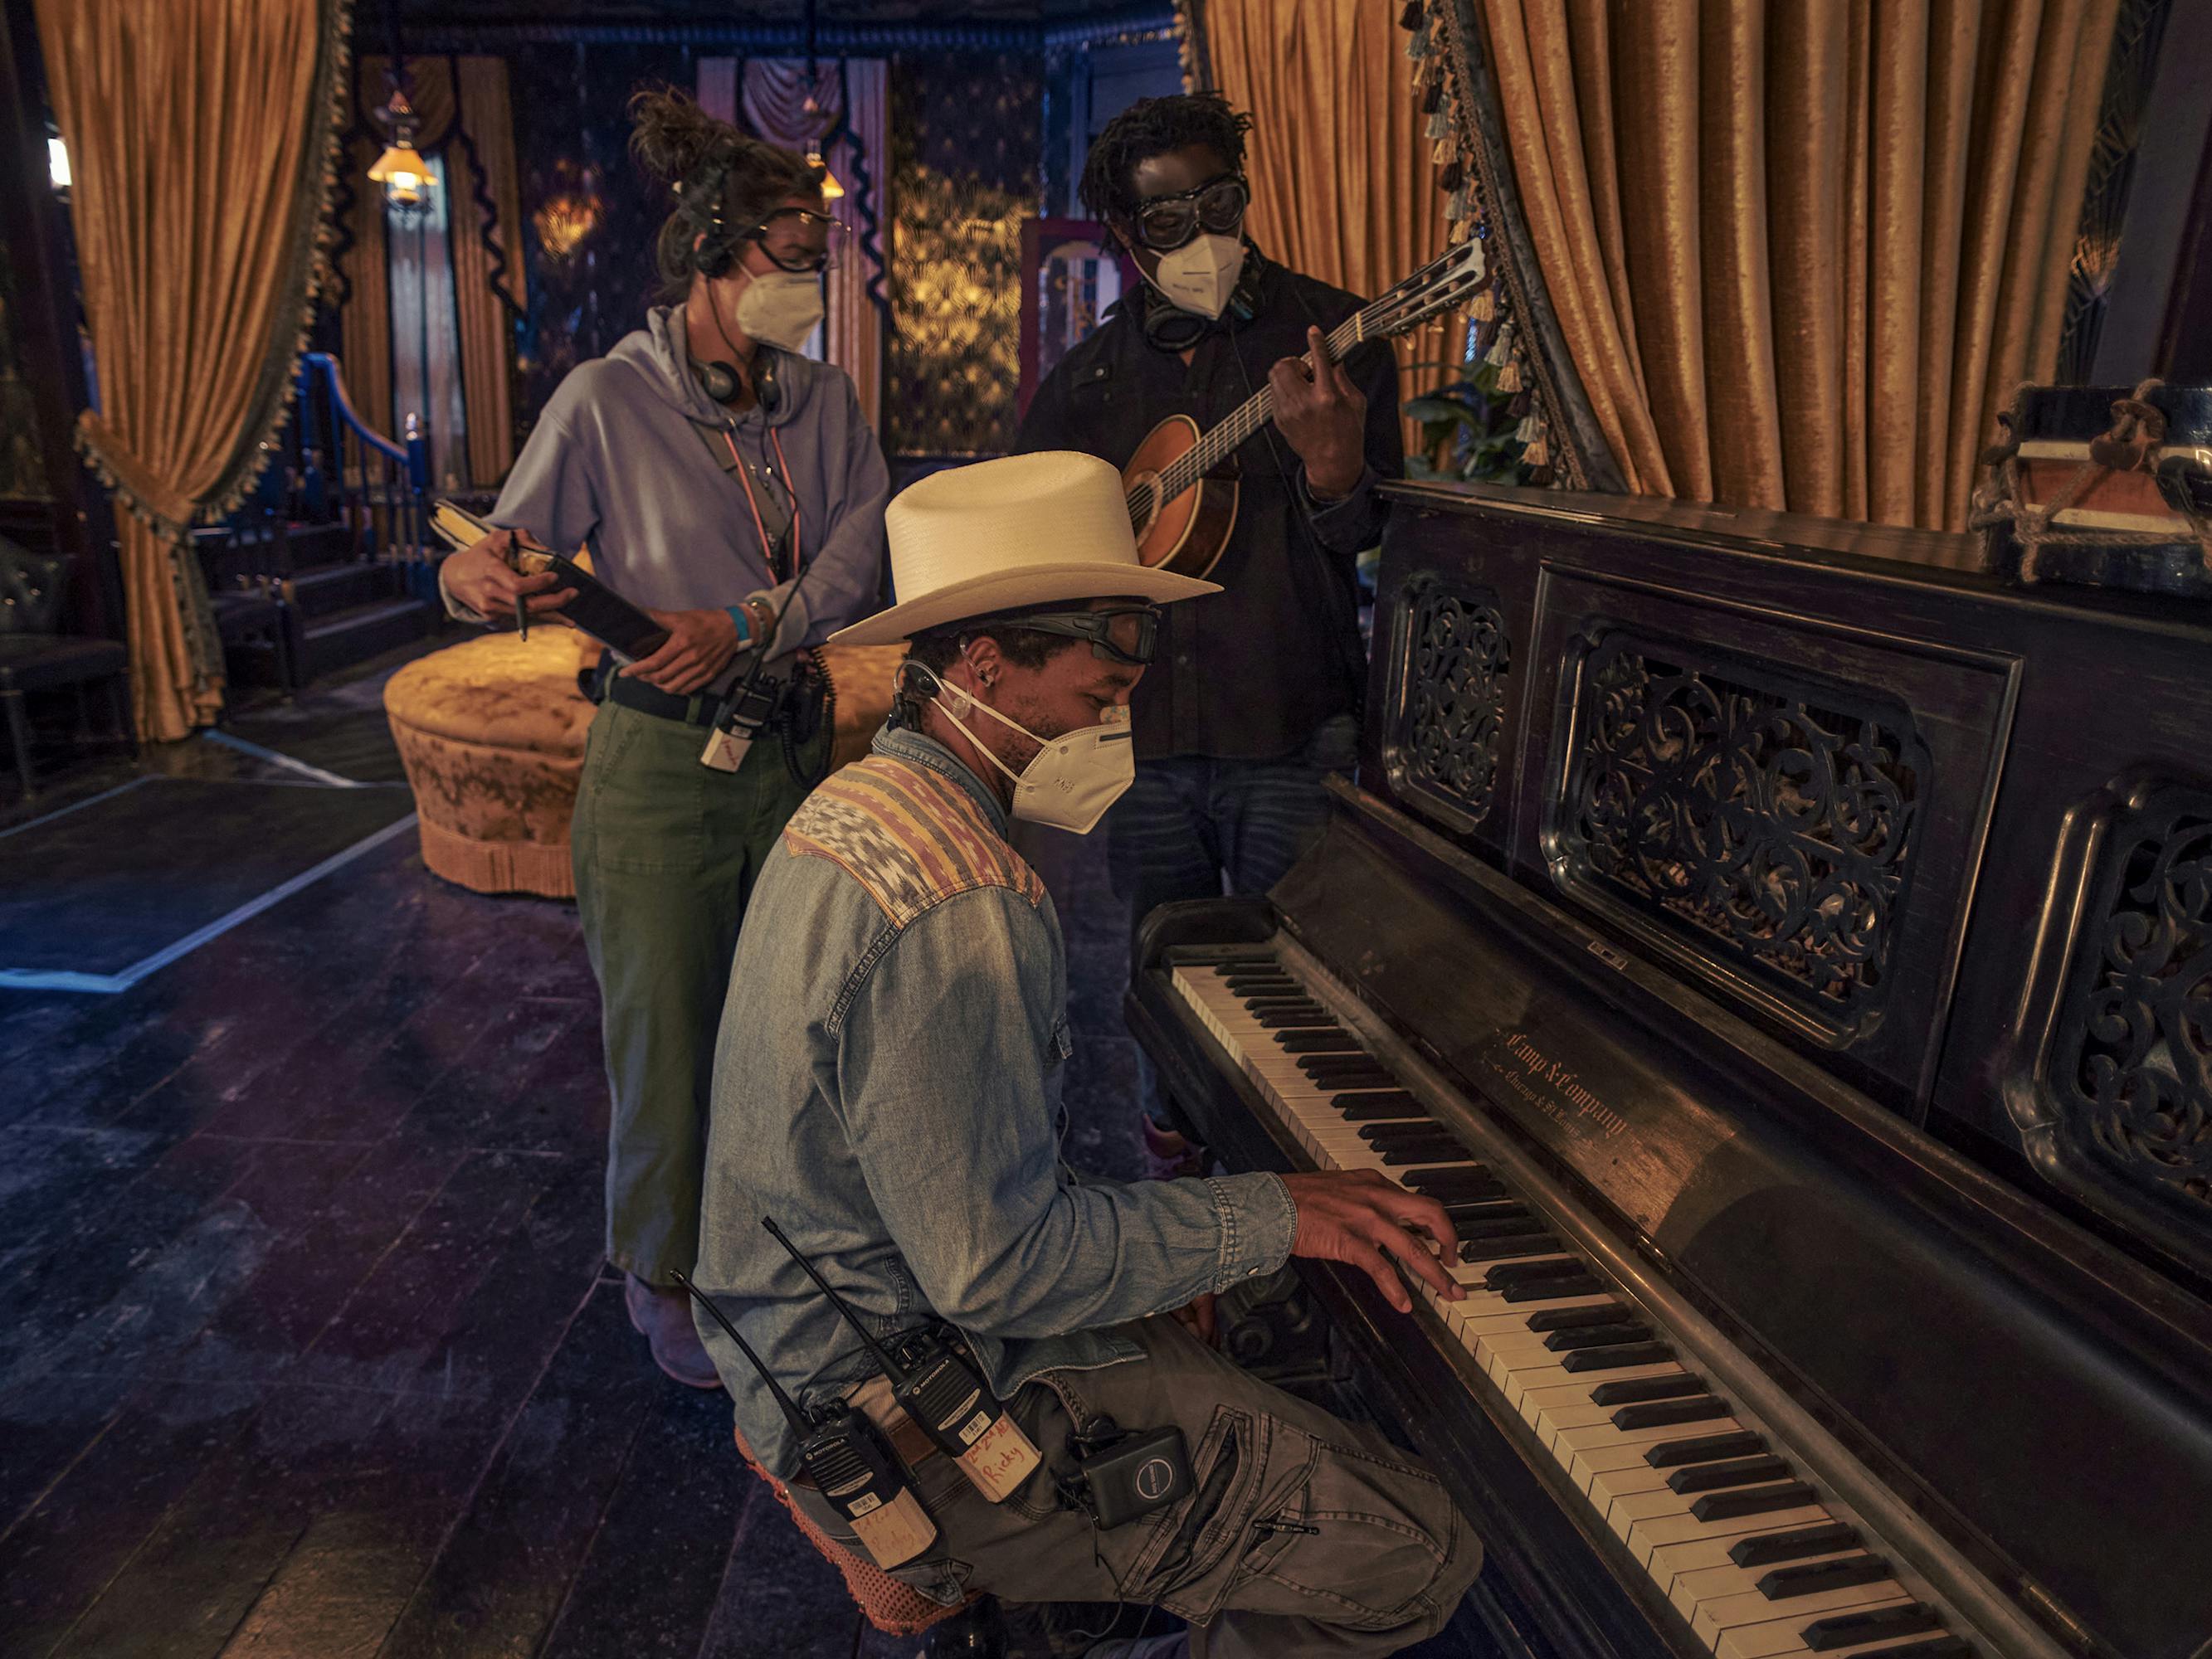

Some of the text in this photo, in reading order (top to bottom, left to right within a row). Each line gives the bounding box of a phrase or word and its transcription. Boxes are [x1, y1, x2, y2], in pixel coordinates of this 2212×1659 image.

[1506, 1034, 1548, 1076] Camp
[1555, 1073, 1629, 1140] Company
[919, 1358, 950, 1389] MOTOROLA
[813, 1438, 845, 1457] MOTOROLA
[982, 1447, 1025, 1484] Ricky
